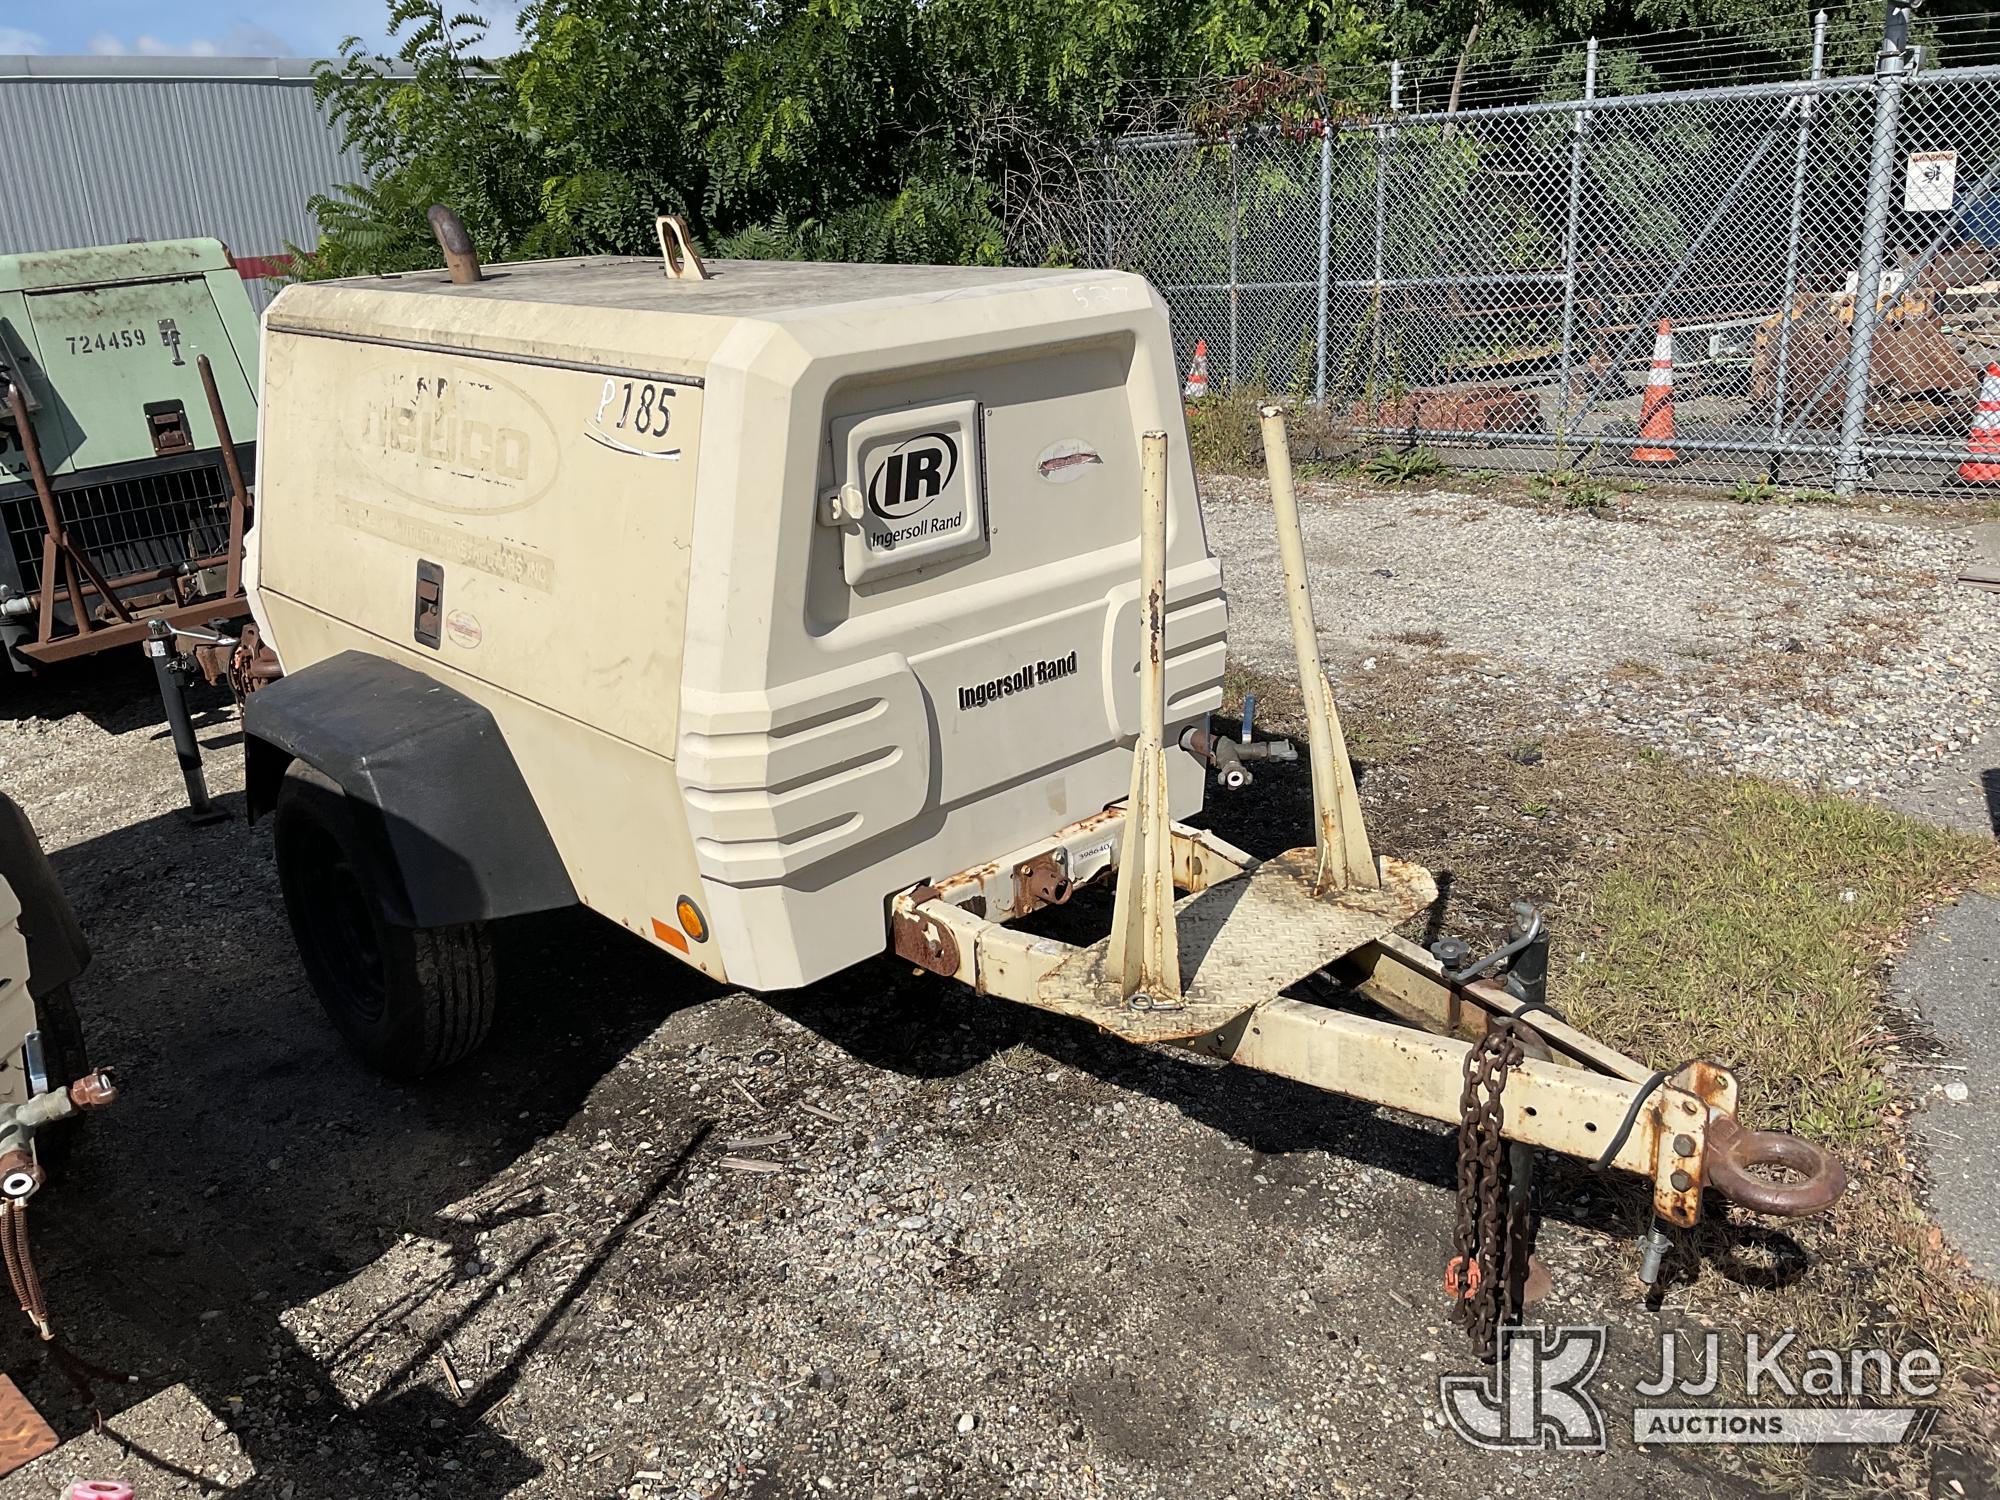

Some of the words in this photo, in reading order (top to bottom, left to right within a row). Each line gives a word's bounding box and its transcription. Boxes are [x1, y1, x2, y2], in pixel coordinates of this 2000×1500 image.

[66, 329, 146, 355] 724459
[884, 448, 942, 507] IR
[872, 520, 928, 547] Ingersoll
[930, 511, 962, 533] Rand
[958, 664, 1034, 710] Ingersoll
[1036, 650, 1077, 685] Rand
